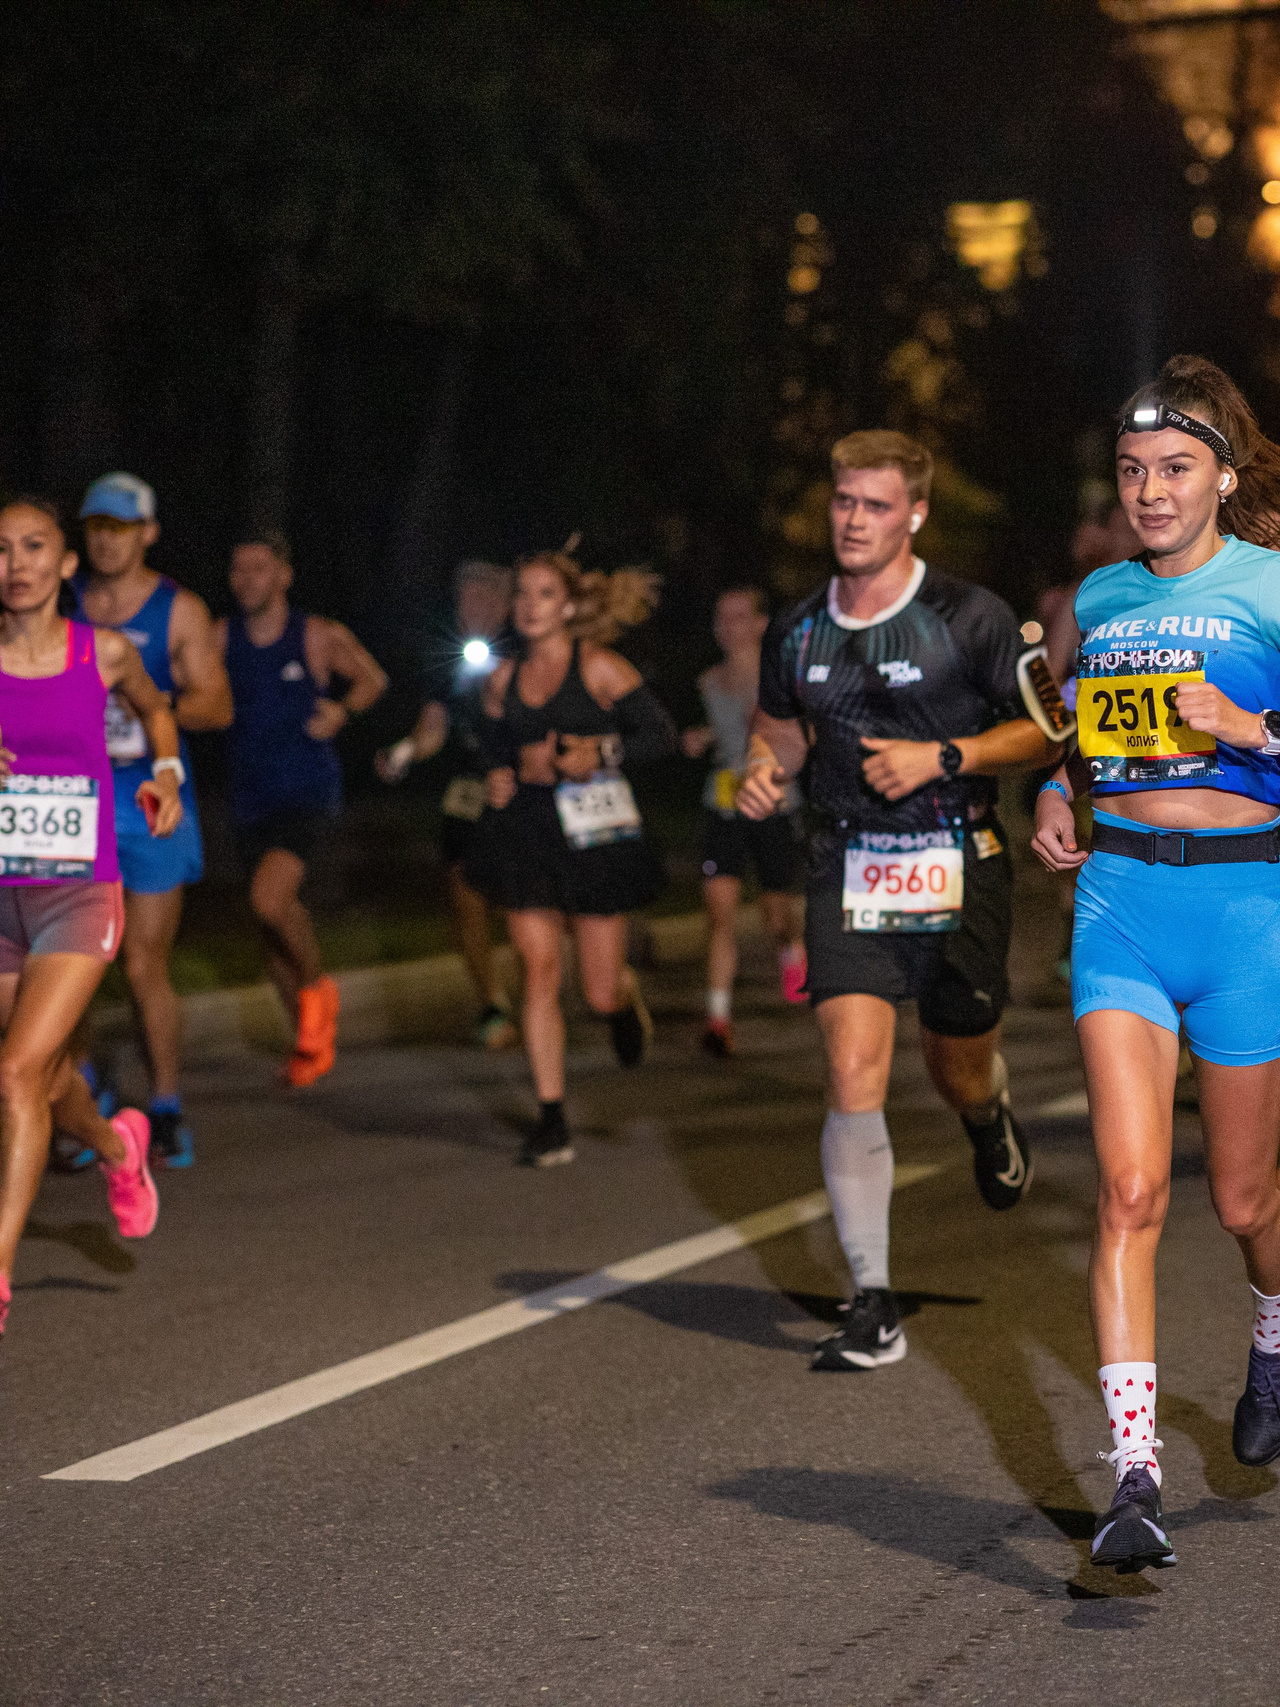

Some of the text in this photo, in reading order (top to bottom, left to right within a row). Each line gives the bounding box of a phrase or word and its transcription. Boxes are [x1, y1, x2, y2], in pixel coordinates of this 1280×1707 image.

[1110, 640, 1159, 650] MOSCOW
[1092, 685, 1183, 733] 2519
[1126, 734, 1160, 748] ЮЛИЯ
[0, 806, 82, 836] 3368
[863, 863, 947, 895] 9560
[860, 910, 874, 924] C
